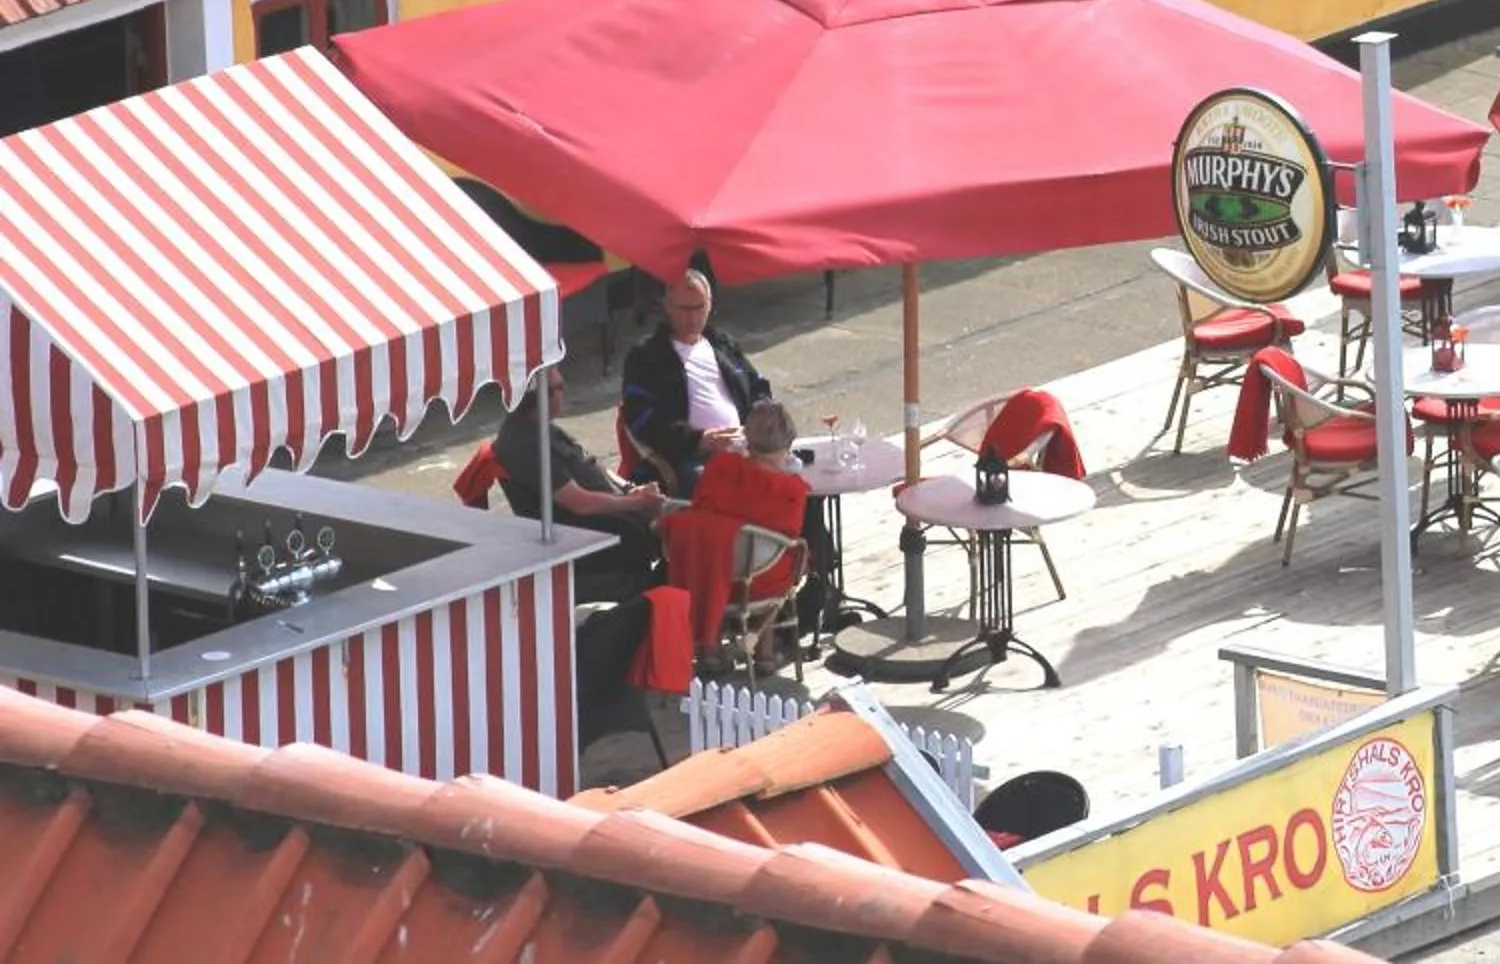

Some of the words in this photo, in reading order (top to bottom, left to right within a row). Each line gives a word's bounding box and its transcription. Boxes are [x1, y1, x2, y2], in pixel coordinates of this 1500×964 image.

[1193, 215, 1230, 244] IRISH
[1231, 223, 1290, 247] STOUT
[1335, 743, 1401, 843] HIRTSHALS
[1400, 761, 1425, 813] KRO
[1191, 808, 1326, 927] KRO
